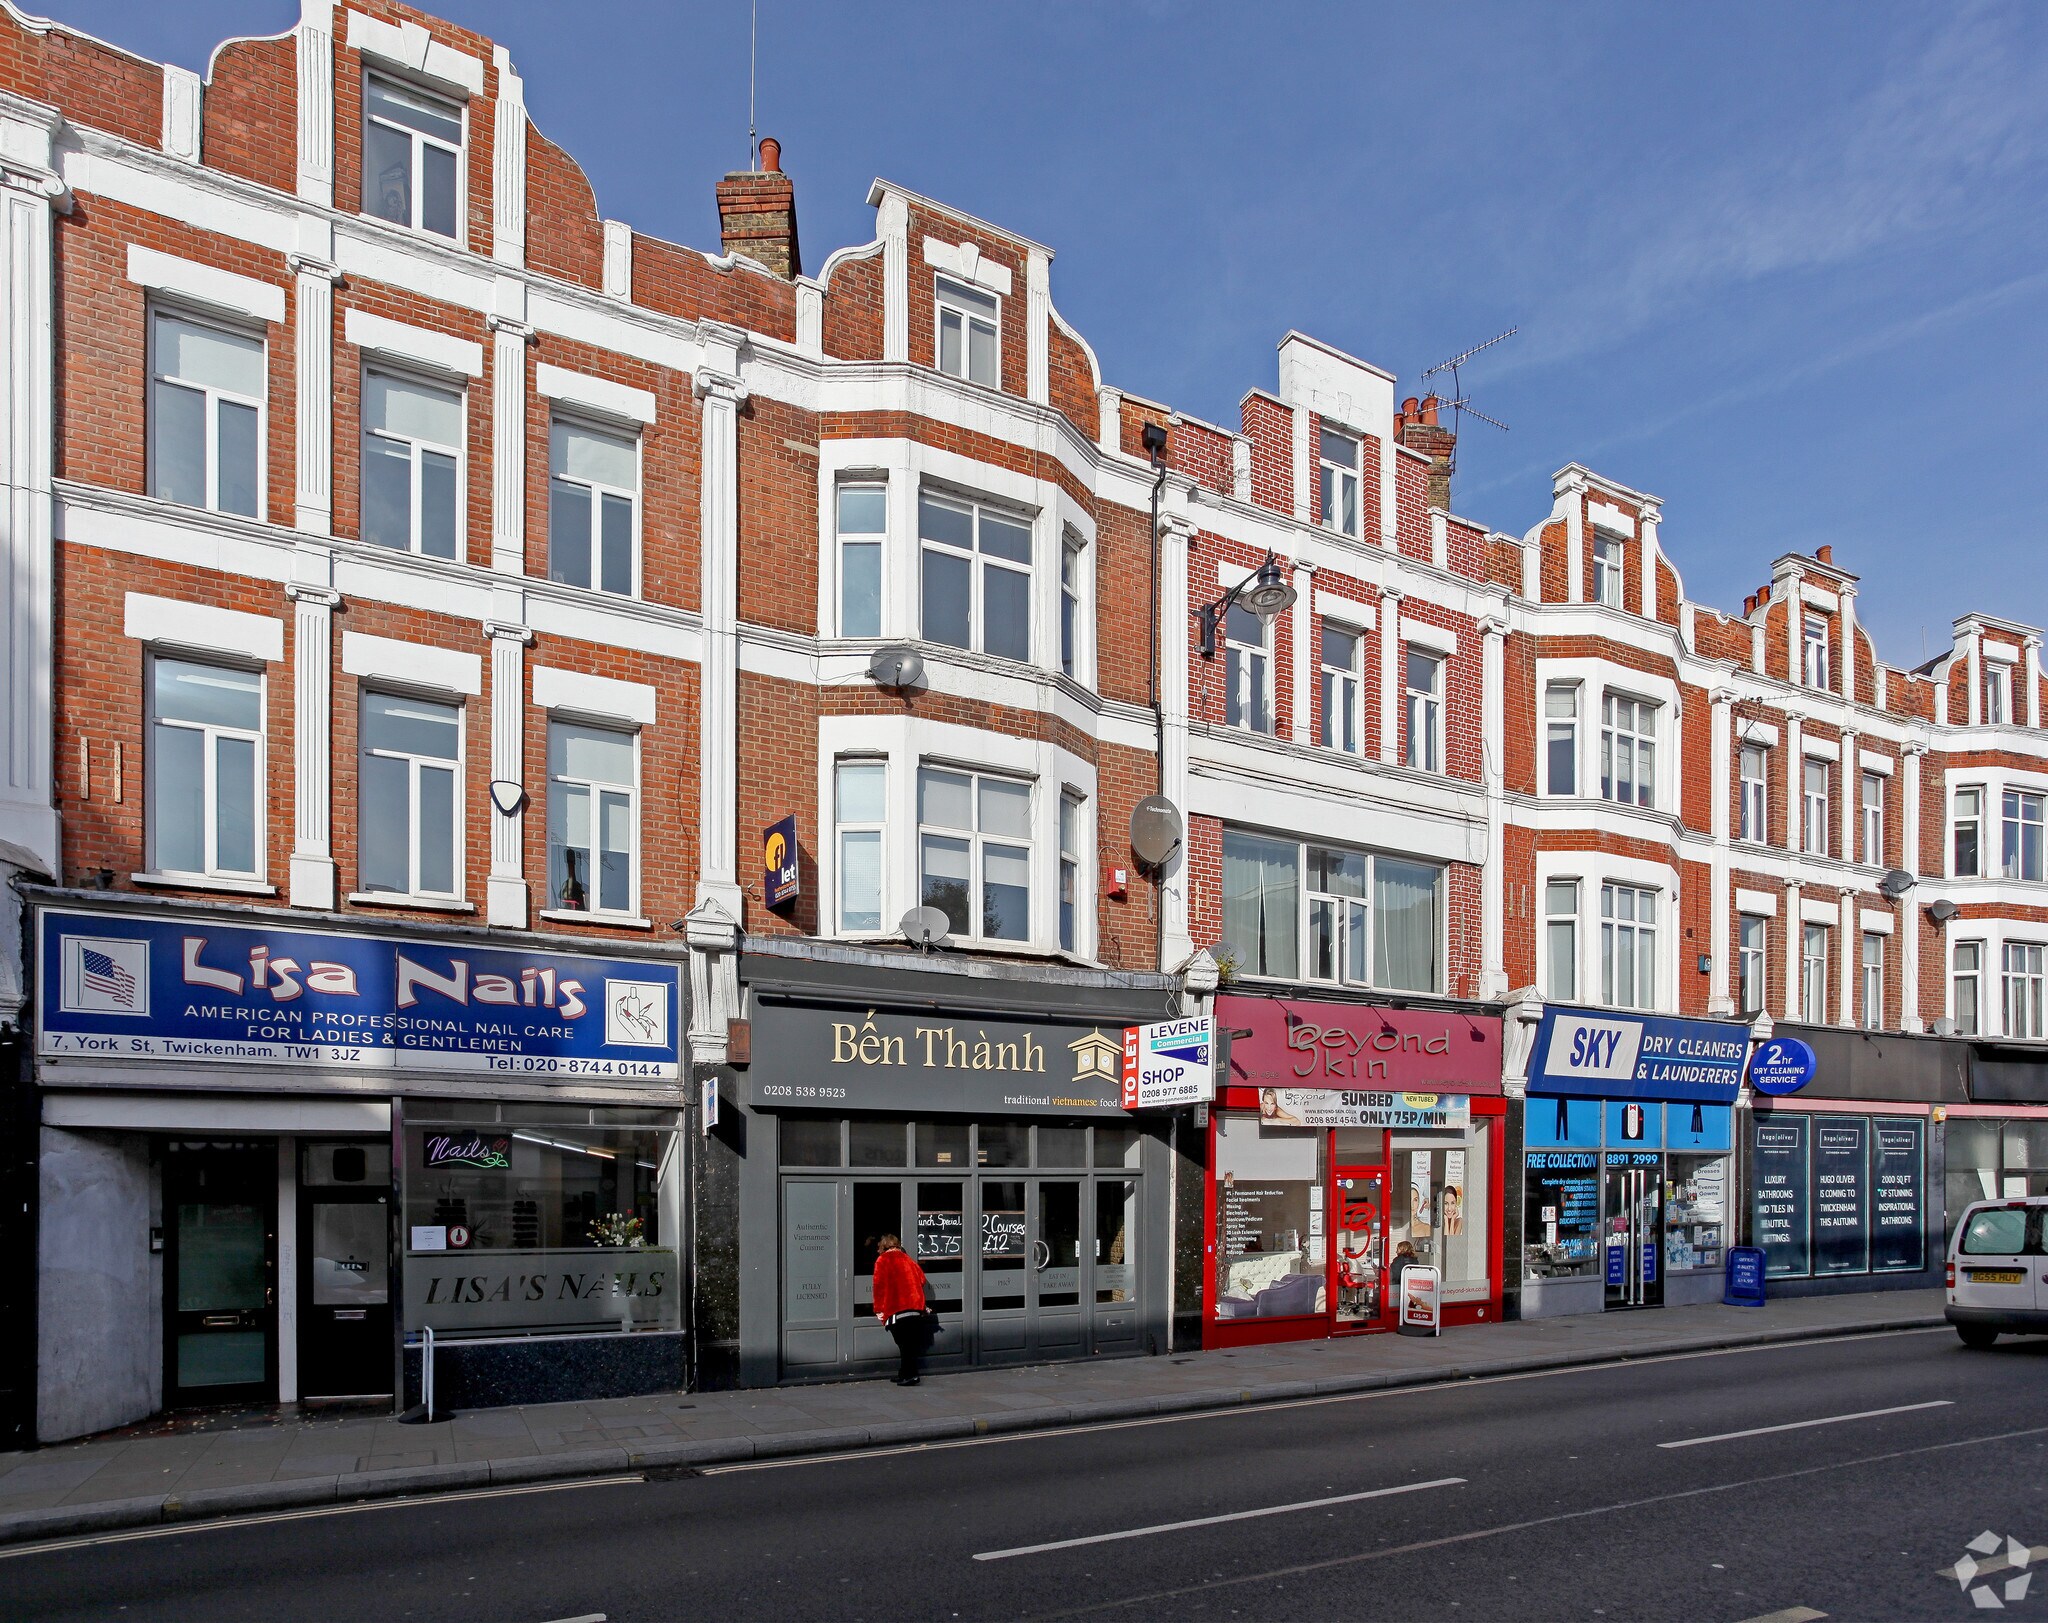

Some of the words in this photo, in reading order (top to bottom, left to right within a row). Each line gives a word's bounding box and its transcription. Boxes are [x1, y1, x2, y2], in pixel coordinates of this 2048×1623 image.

[781, 863, 796, 885] let
[182, 935, 361, 1002] Lisa
[397, 953, 588, 1021] Nails
[184, 1004, 303, 1023] AMERICAN
[312, 1012, 468, 1034] PROFESSIONAL
[475, 1022, 518, 1037] NAIL
[524, 1025, 575, 1039] CARE
[1150, 1018, 1209, 1039] LEVENE
[247, 1025, 291, 1040] FOR
[299, 1028, 374, 1045] LADIES
[381, 1032, 394, 1046] &
[403, 1034, 523, 1052] GENTLEMEN
[831, 1008, 908, 1067] Bến
[915, 1027, 1047, 1074] Thành
[1156, 1035, 1202, 1048] Commercial
[52, 1034, 69, 1051] 7,
[75, 1035, 119, 1050] York
[131, 1037, 155, 1055] St,
[162, 1039, 278, 1058] Twickenham.
[284, 1046, 320, 1060] TW1
[331, 1047, 361, 1061] 3JZ
[1125, 1030, 1137, 1070] LET
[1569, 1026, 1622, 1069] SKY
[1642, 1035, 1674, 1054] DRY
[1678, 1038, 1743, 1059] CLEANERS
[617, 1063, 662, 1077] 0144
[1142, 1066, 1185, 1086] SHOP
[1637, 1062, 1648, 1080] &
[1652, 1064, 1738, 1085] LAUNDERERS
[1753, 1067, 1768, 1075] DRY
[1770, 1067, 1805, 1075] CLEANING
[1759, 1076, 1797, 1084] SERVICE
[763, 1085, 792, 1096] 0208
[795, 1086, 816, 1097] 538
[819, 1087, 846, 1098] 9523
[1124, 1076, 1137, 1106] TO
[1141, 1088, 1160, 1099] 0208
[1162, 1087, 1177, 1097] 977
[1179, 1085, 1198, 1095] 6885
[1004, 1095, 1050, 1105] traditional
[1052, 1096, 1098, 1107] vietnamese
[1100, 1097, 1117, 1107] food
[1341, 1092, 1394, 1108] SUNBED
[1305, 1116, 1324, 1124] 0208
[1325, 1116, 1338, 1124] 891
[1339, 1116, 1358, 1124] 4542
[1359, 1110, 1393, 1125] ONLY
[1394, 1111, 1447, 1127] 75P/MIN
[427, 1136, 491, 1162] Nails
[1526, 1153, 1547, 1168] FREE
[1547, 1153, 1597, 1168] COLLECTION
[1606, 1154, 1629, 1165] 8891
[1633, 1154, 1658, 1165] 2999
[1541, 1178, 1558, 1186] Complete
[1764, 1175, 1787, 1184] LUXURY
[1820, 1175, 1835, 1184] HUGO
[1835, 1175, 1855, 1184] OLIVER
[1881, 1175, 1896, 1184] 2000
[1896, 1175, 1904, 1185] SQ
[1904, 1175, 1911, 1184] FT
[1697, 1184, 1720, 1193] Evening
[1757, 1189, 1793, 1199] BATHROOMS
[1819, 1189, 1825, 1198] IS
[1825, 1189, 1847, 1198] COMING
[1847, 1189, 1856, 1197] TO
[1880, 1189, 1888, 1198] OF
[1888, 1189, 1913, 1198] STUNNING
[1770, 1204, 1786, 1213] TILES
[1787, 1204, 1794, 1213] IN
[1820, 1203, 1856, 1212] TWICKENHAM
[1878, 1202, 1916, 1211] INSPIRATIONAL
[795, 1223, 828, 1231] Authentic
[918, 1214, 935, 1226] unch
[935, 1213, 963, 1231] Special
[991, 1214, 1026, 1235] Courses
[1819, 1217, 1832, 1226] THIS
[1832, 1217, 1858, 1226] AUTUMN
[1881, 1216, 1913, 1225] BATHROOMS
[983, 1233, 1010, 1251] £12
[1998, 1273, 2019, 1282] HUY
[422, 1274, 548, 1305] LISA'S
[556, 1270, 666, 1300] NAILS
